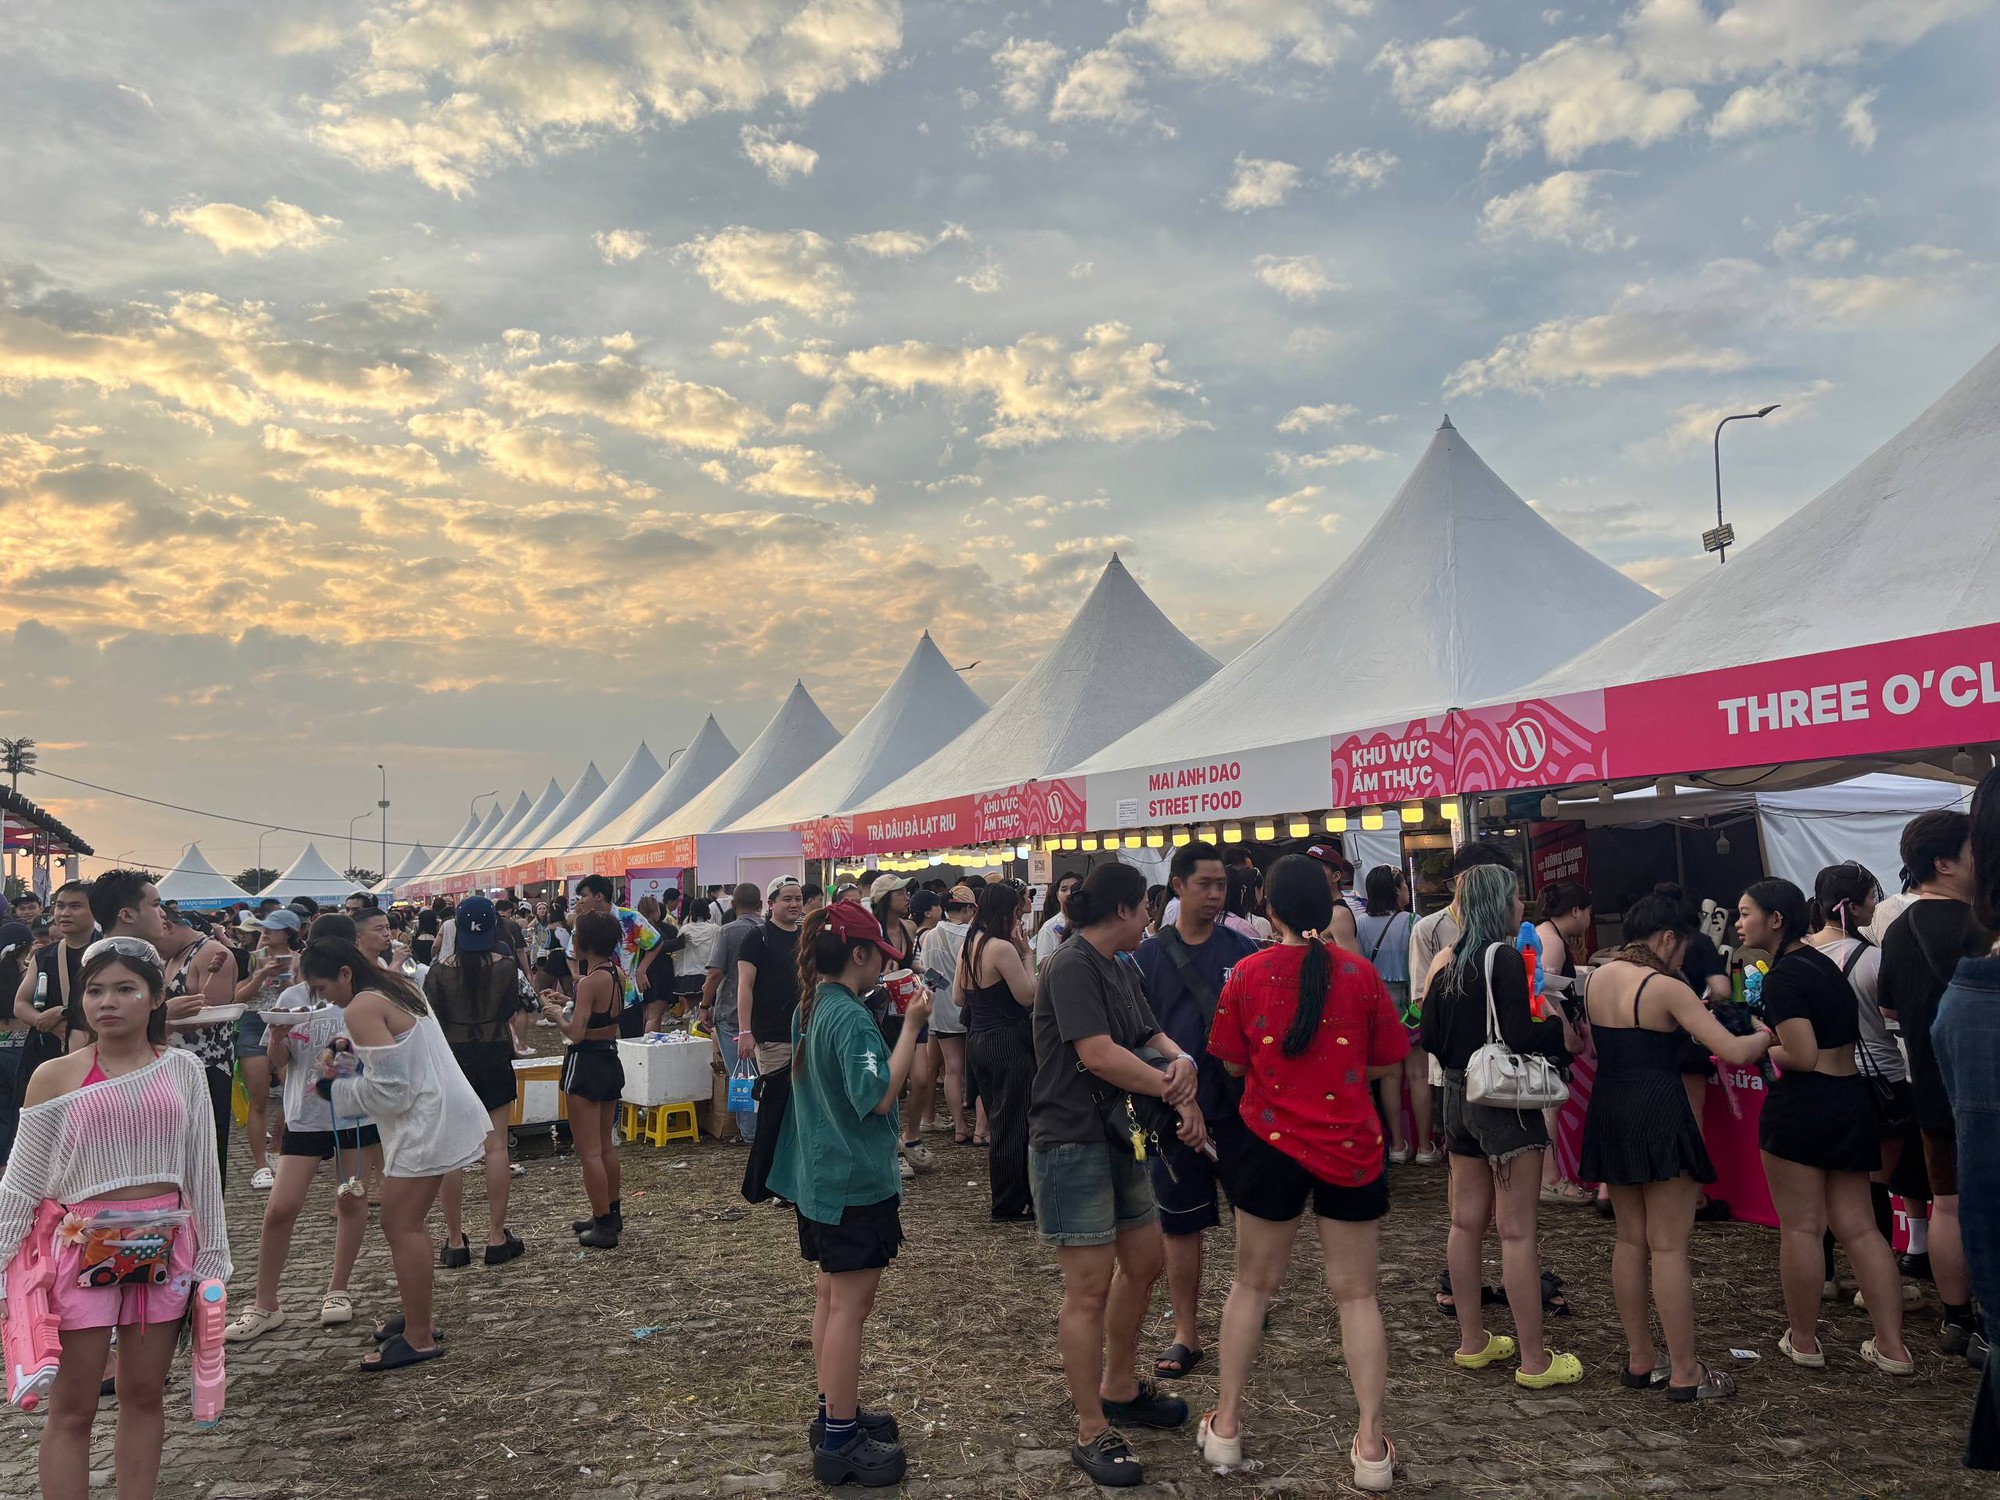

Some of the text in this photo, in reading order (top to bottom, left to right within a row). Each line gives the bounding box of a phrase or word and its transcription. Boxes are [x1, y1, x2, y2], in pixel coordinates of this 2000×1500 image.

[1718, 680, 1869, 735] THREE
[1352, 739, 1430, 768] KHU VỰC
[1149, 761, 1241, 791] MAI ANH DAO
[1352, 765, 1432, 793] ẨM THỰC
[984, 796, 1019, 814] KHU VỰC
[1149, 795, 1198, 817] STREET
[1202, 790, 1242, 812] FOOD
[867, 820, 884, 841] TRÀ
[885, 818, 904, 840] DÂU
[920, 816, 939, 838] LẠT
[939, 813, 956, 832] RIU
[997, 813, 1020, 830] THỰC
